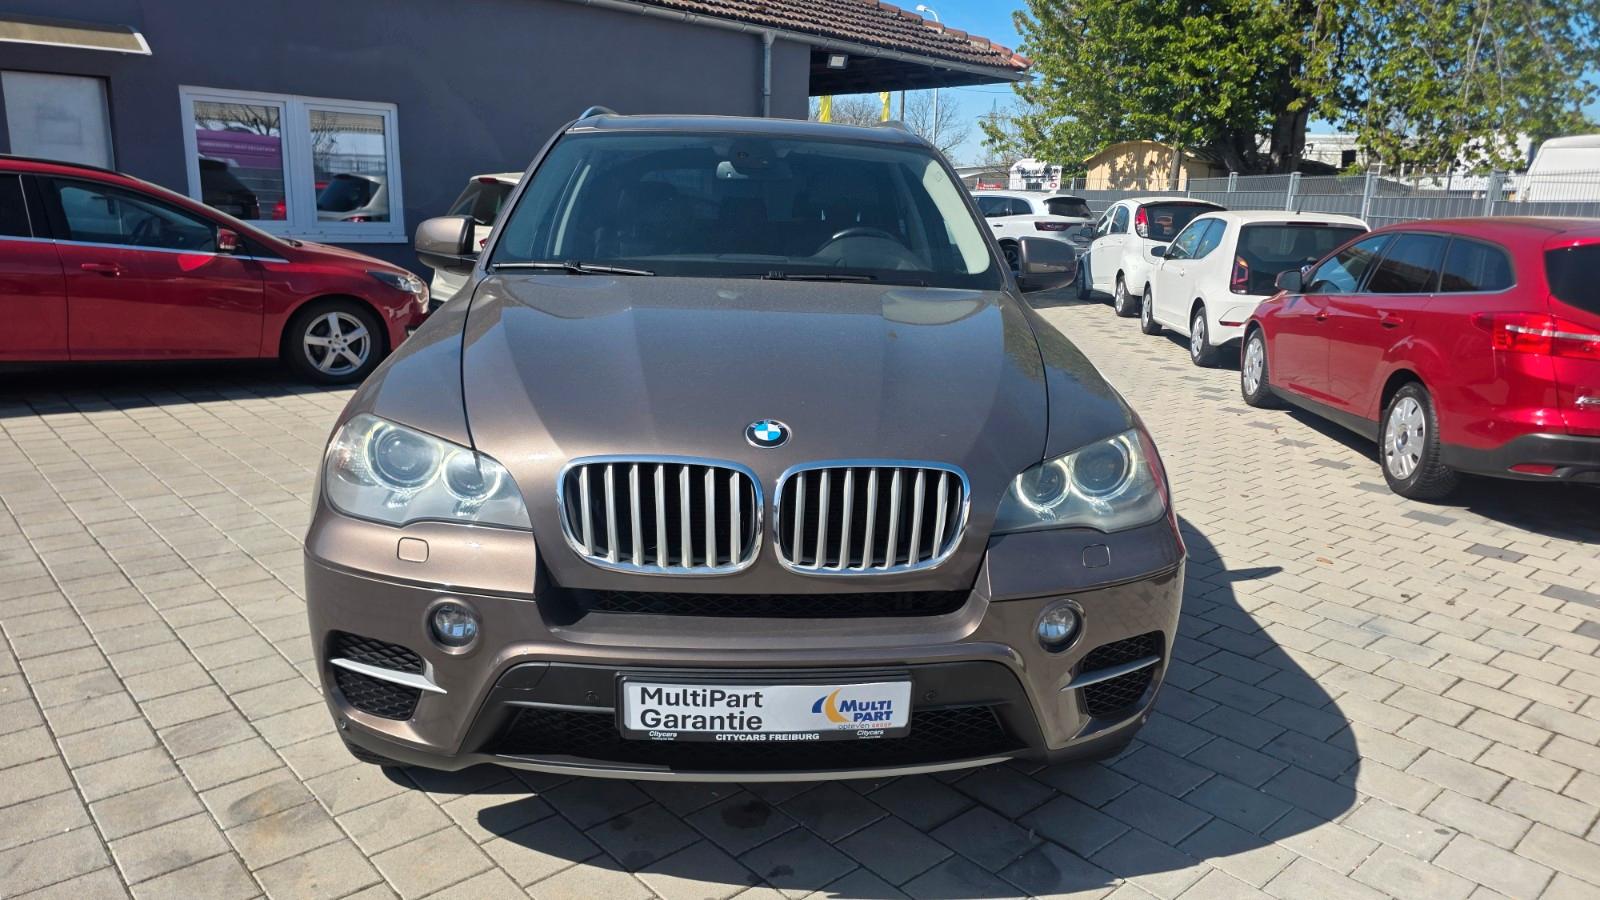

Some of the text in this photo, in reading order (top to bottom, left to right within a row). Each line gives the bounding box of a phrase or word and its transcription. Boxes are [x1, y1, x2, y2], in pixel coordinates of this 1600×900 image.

[640, 686, 763, 708] MultiPart
[640, 708, 763, 731] Garantie
[853, 710, 893, 722] PART
[648, 730, 678, 739] Citycars
[715, 732, 820, 741] CITYCARS FREIBURG
[856, 729, 884, 737] Citycars
